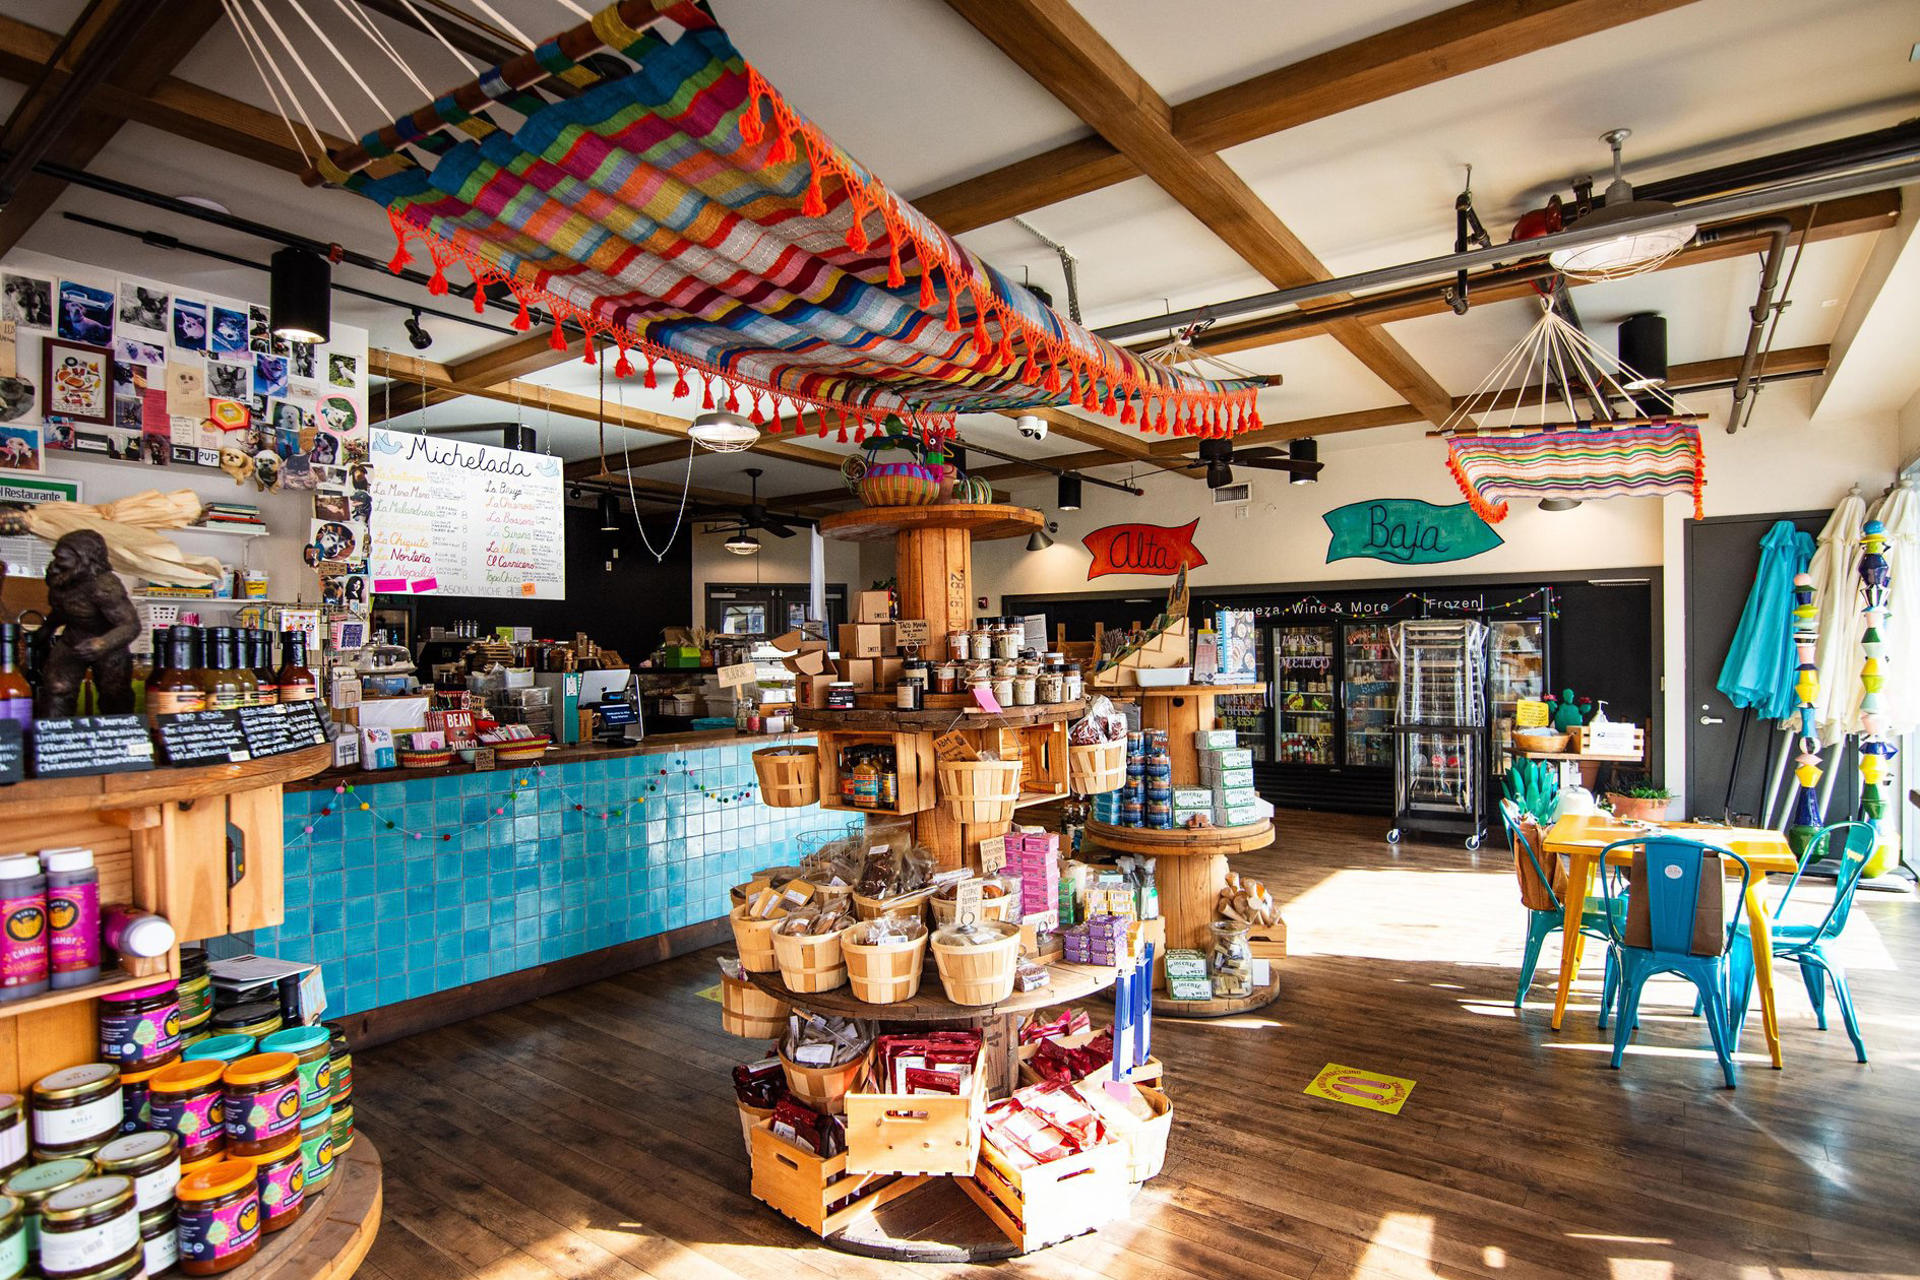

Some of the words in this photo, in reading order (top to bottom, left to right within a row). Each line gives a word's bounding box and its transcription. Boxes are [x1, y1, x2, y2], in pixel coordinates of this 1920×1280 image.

[198, 451, 219, 463] PUP
[406, 437, 531, 478] Michelada
[373, 482, 386, 496] La
[485, 480, 497, 493] La
[5, 487, 61, 501] Restaurante
[374, 500, 388, 512] La
[487, 510, 501, 523] La
[1363, 505, 1449, 561] Baja
[486, 541, 500, 553] La
[390, 548, 431, 563] Norteña
[487, 556, 497, 568] El
[375, 563, 391, 577] La
[435, 583, 473, 595] EASONAL
[479, 584, 501, 595] MICHE
[1292, 602, 1327, 613] Wine
[1334, 602, 1343, 613] &
[1351, 602, 1388, 612] More
[1429, 598, 1479, 608] Frozen
[36, 719, 73, 730] Ghost
[446, 713, 471, 728] BEAN
[12, 945, 45, 960] CHAMOY
